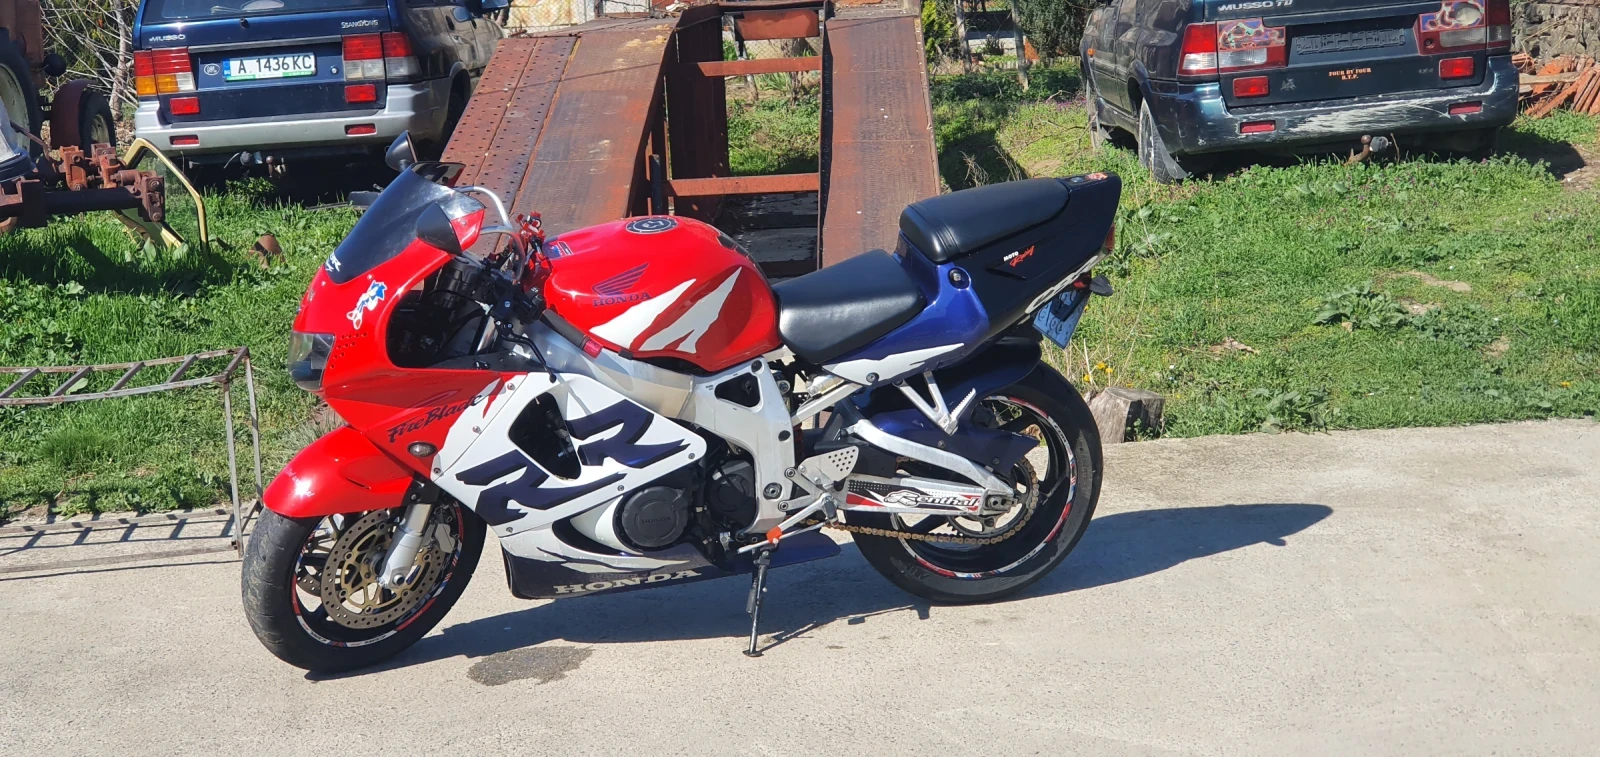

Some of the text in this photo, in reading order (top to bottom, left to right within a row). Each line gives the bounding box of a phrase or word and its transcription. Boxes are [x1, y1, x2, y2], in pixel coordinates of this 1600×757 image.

[1218, 1, 1274, 11] MUSSO
[149, 33, 186, 42] MUSSO
[238, 59, 247, 74] A
[1003, 250, 1019, 262] MOTO
[592, 290, 652, 307] HONDA
[884, 489, 981, 508] Renthal
[553, 569, 702, 594] HONDA
